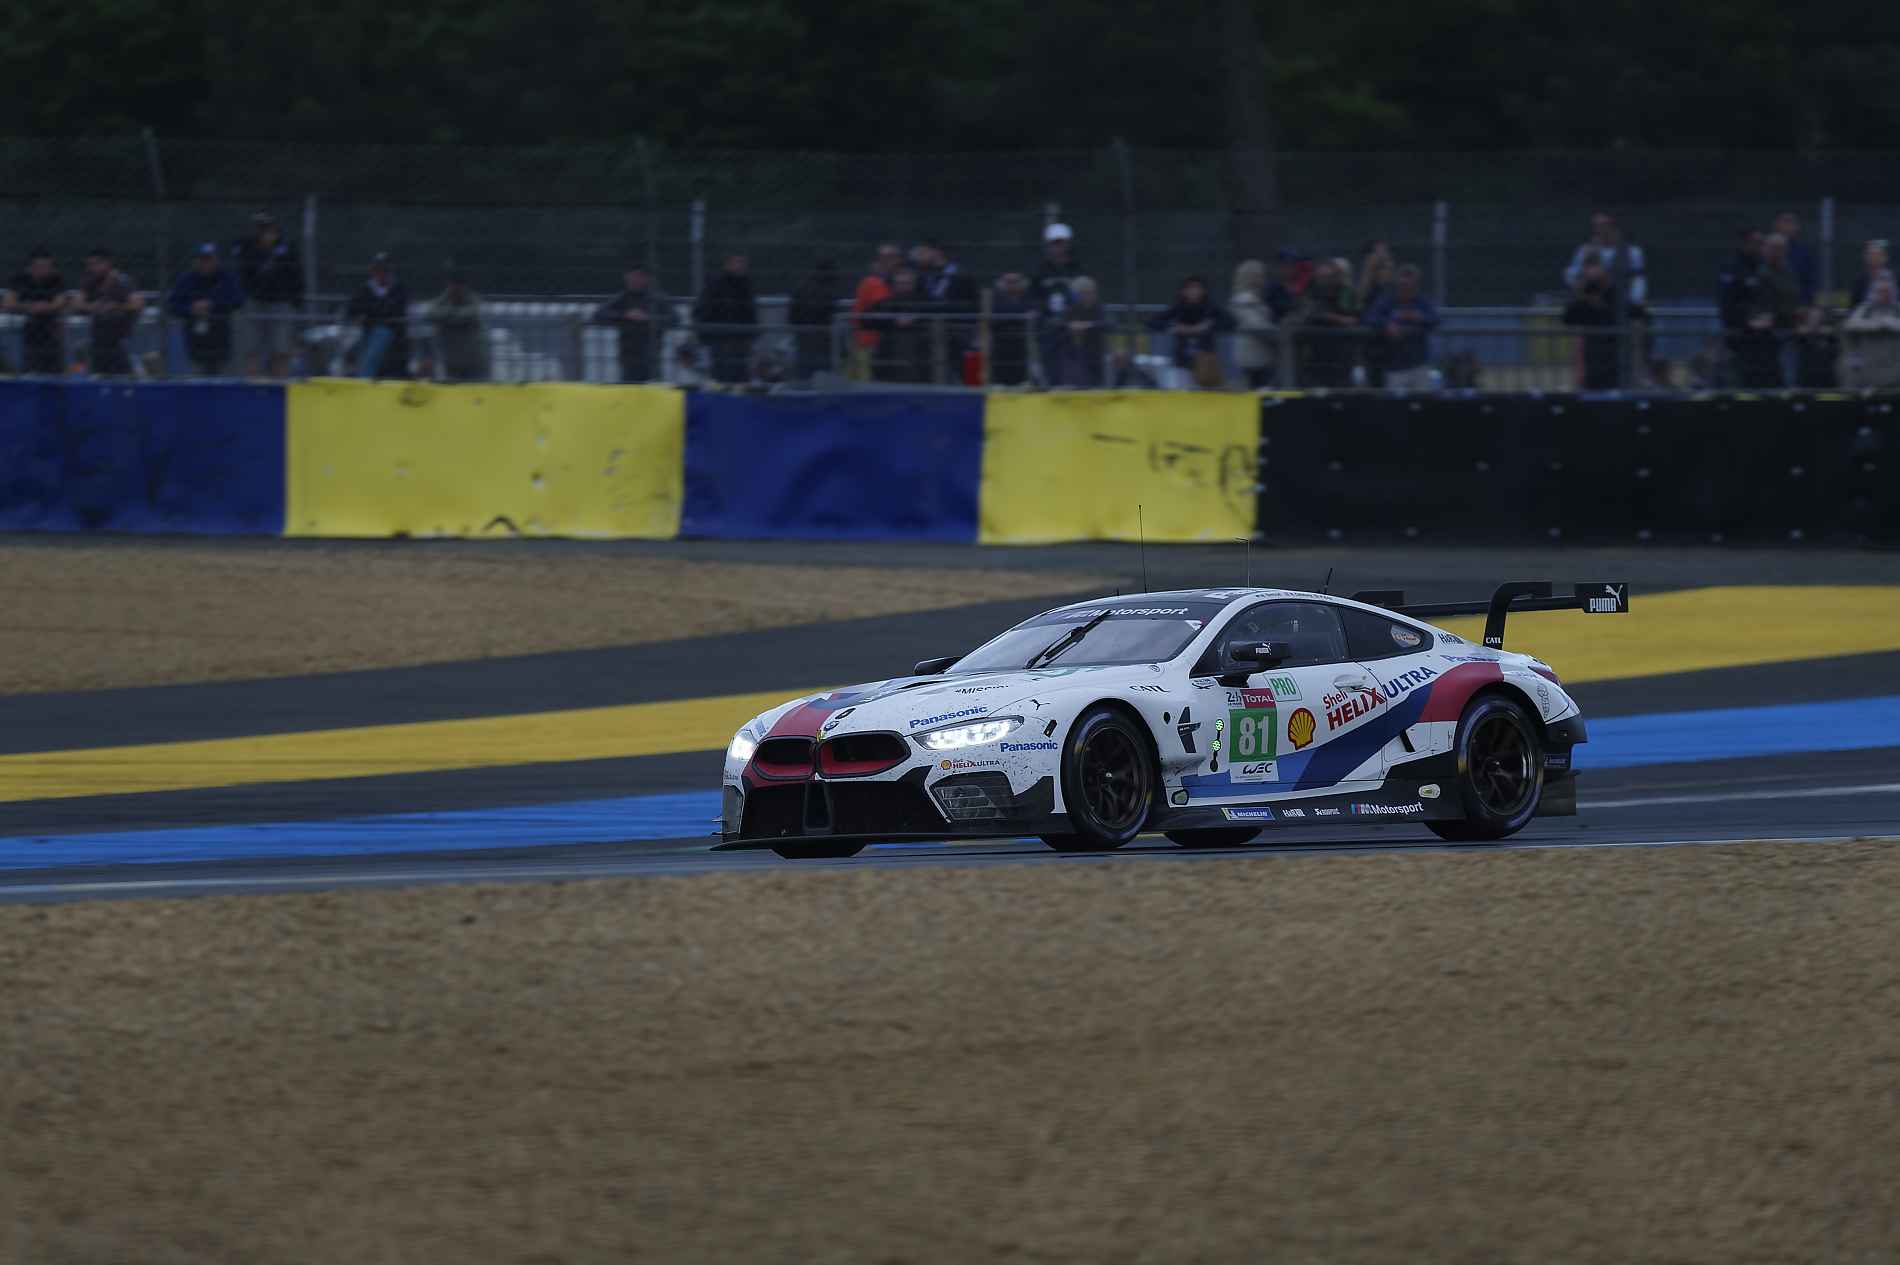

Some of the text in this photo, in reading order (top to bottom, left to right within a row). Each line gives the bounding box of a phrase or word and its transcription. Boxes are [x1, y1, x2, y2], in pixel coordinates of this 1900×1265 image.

[1589, 598, 1617, 612] PUMA
[1485, 636, 1501, 644] CATL
[1268, 678, 1297, 696] PRO
[1243, 694, 1275, 703] TOTAL
[1322, 690, 1348, 710] Shell
[1327, 666, 1438, 732] HELIX ULTRA
[909, 706, 988, 728] Panasonic
[1238, 716, 1270, 756] 81
[1000, 740, 1059, 753] Panasonic
[952, 759, 1000, 769] HELIX ULTRA
[1243, 762, 1273, 775] WEC
[1371, 801, 1425, 815] Motorsport
